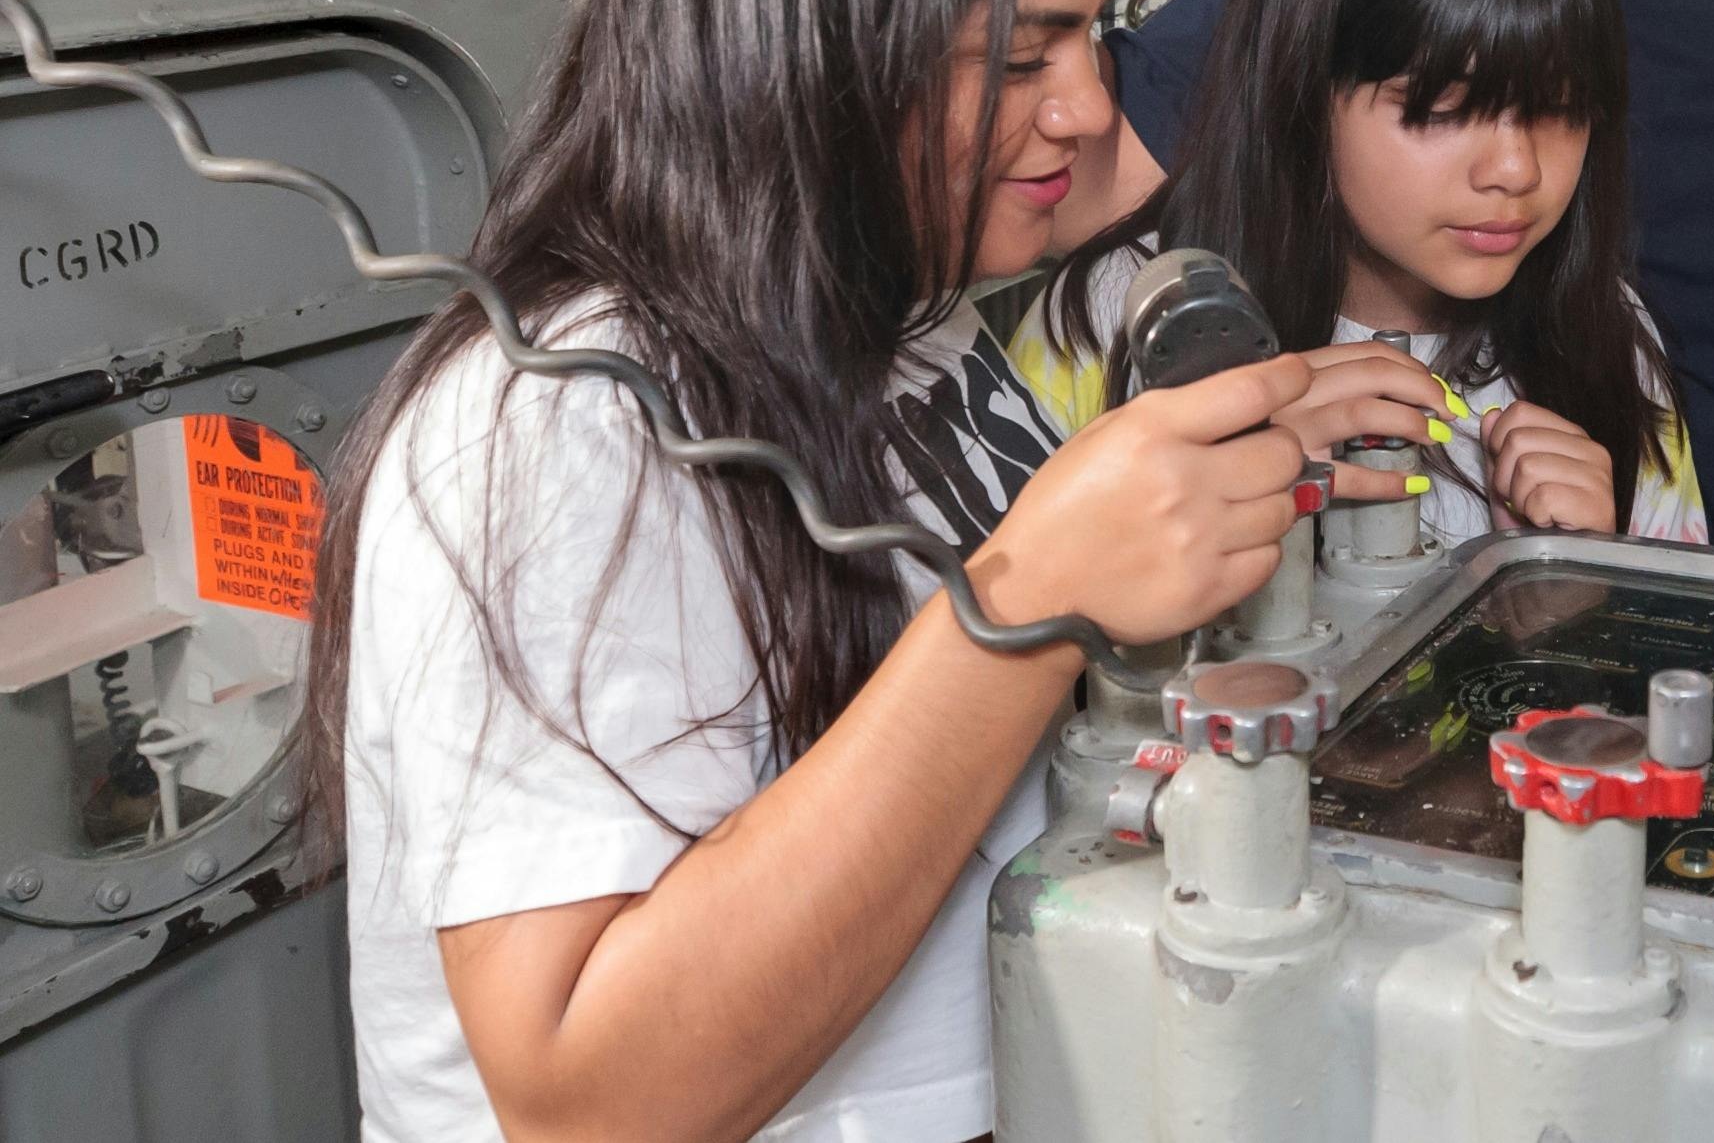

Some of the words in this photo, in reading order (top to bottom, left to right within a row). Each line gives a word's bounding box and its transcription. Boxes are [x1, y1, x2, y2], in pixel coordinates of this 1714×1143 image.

[19, 220, 159, 289] CGRD
[196, 460, 220, 487] EAR
[225, 466, 302, 504] PROTECTION
[257, 526, 285, 547] ACTIVE
[213, 538, 265, 562] PLUGS
[272, 550, 304, 570] AND
[214, 558, 269, 582] WITHIN
[216, 578, 267, 601] INSIDE
